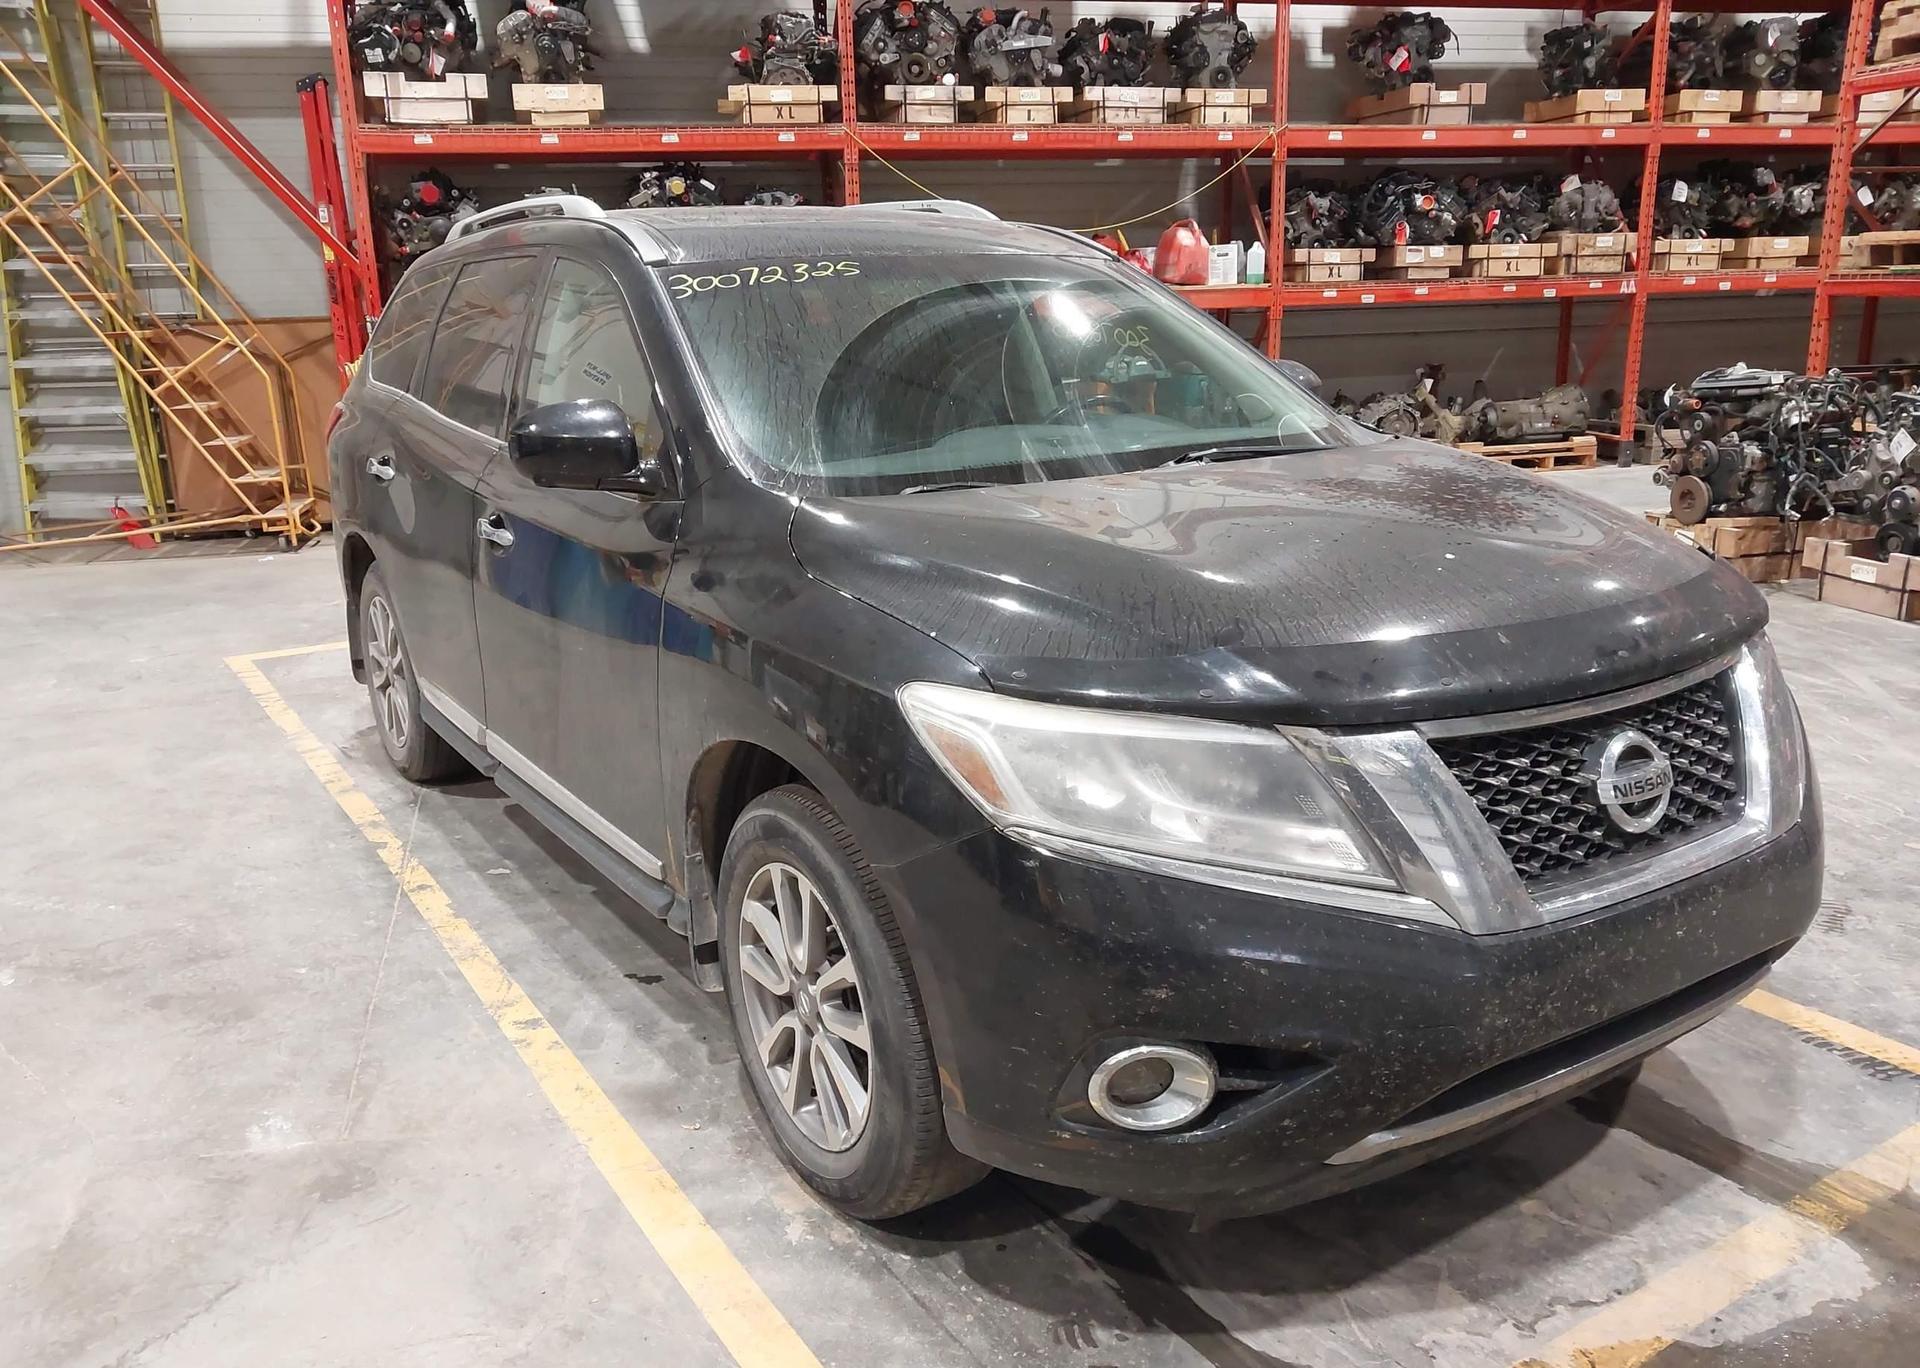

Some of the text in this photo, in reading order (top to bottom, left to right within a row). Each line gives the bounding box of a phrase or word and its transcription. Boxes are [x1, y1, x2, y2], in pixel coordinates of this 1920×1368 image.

[668, 261, 861, 300] 30072325
[1619, 280, 1637, 294] AA
[1612, 770, 1671, 800] NISSAN
